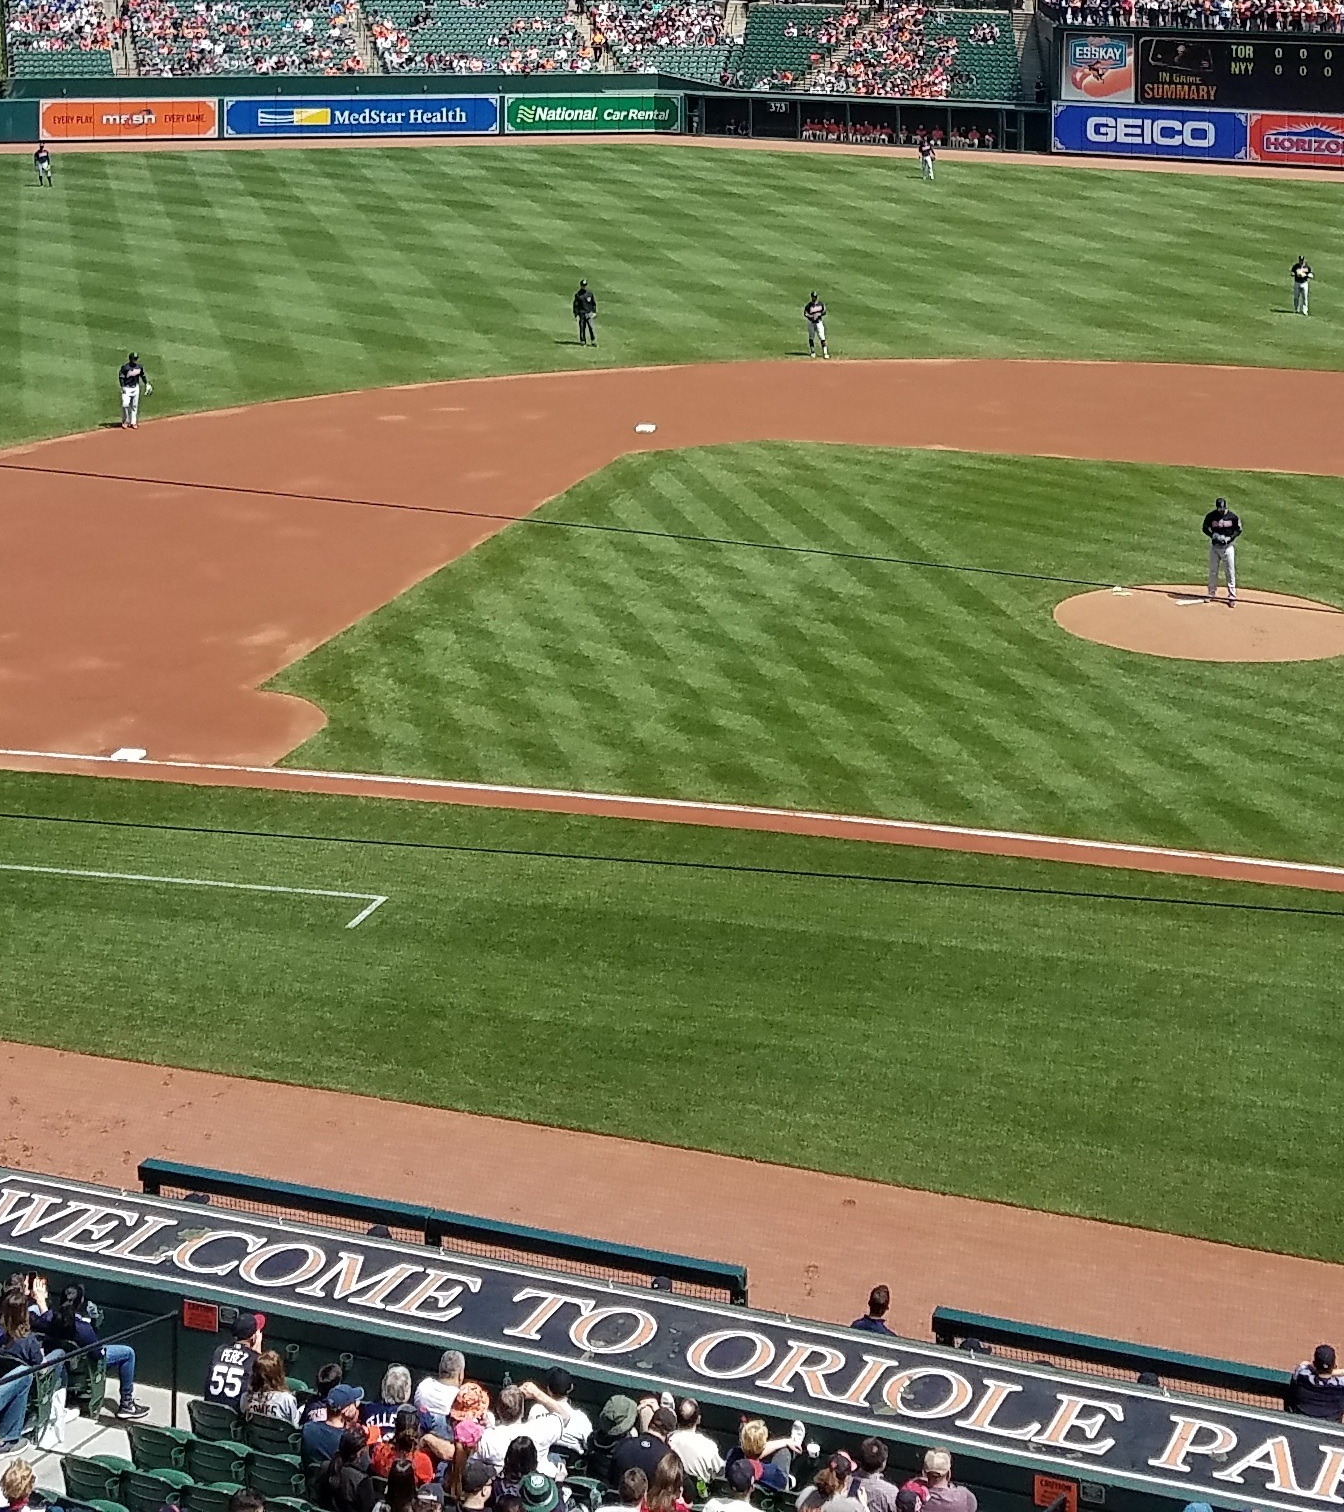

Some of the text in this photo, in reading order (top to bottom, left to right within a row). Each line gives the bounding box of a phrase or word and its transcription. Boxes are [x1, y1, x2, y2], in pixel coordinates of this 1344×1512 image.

[1075, 46, 1124, 61] ESSKAY
[1230, 45, 1332, 60] TOR 0 0 0
[1158, 71, 1202, 84] IN GAME
[1230, 61, 1332, 78] NYY 0 0 0
[1144, 83, 1217, 101] SUMMARY
[334, 107, 467, 125] MedStar Health
[603, 109, 627, 121] Car
[628, 108, 670, 121] Rental
[769, 103, 787, 113] 373
[53, 115, 75, 125] EVERY
[164, 114, 185, 123] EVERY
[1087, 116, 1215, 147] GEICO
[221, 1348, 250, 1365] PEREZ
[503, 1287, 658, 1354] TO
[685, 1329, 1126, 1456] ORIOLE
[209, 1365, 245, 1398] 55
